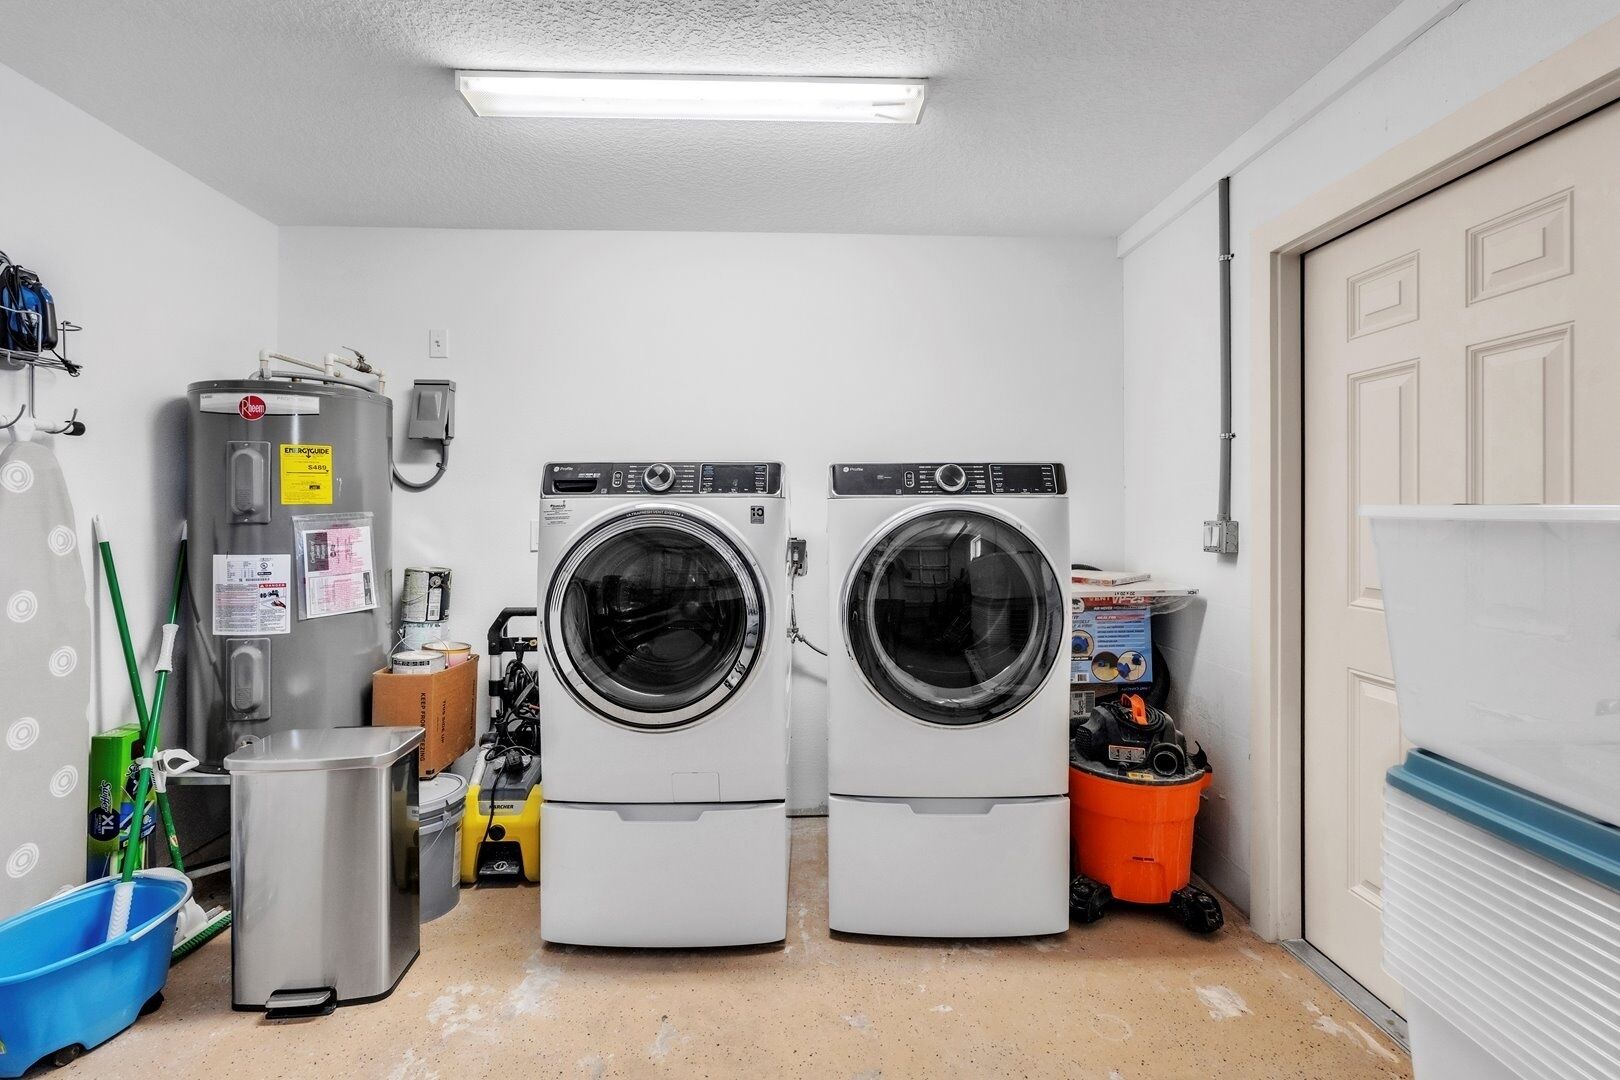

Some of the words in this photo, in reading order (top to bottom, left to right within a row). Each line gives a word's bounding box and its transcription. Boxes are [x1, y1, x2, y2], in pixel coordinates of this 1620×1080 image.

[241, 395, 265, 416] Rheem
[99, 779, 112, 813] Swiffer
[101, 814, 114, 835] XL
